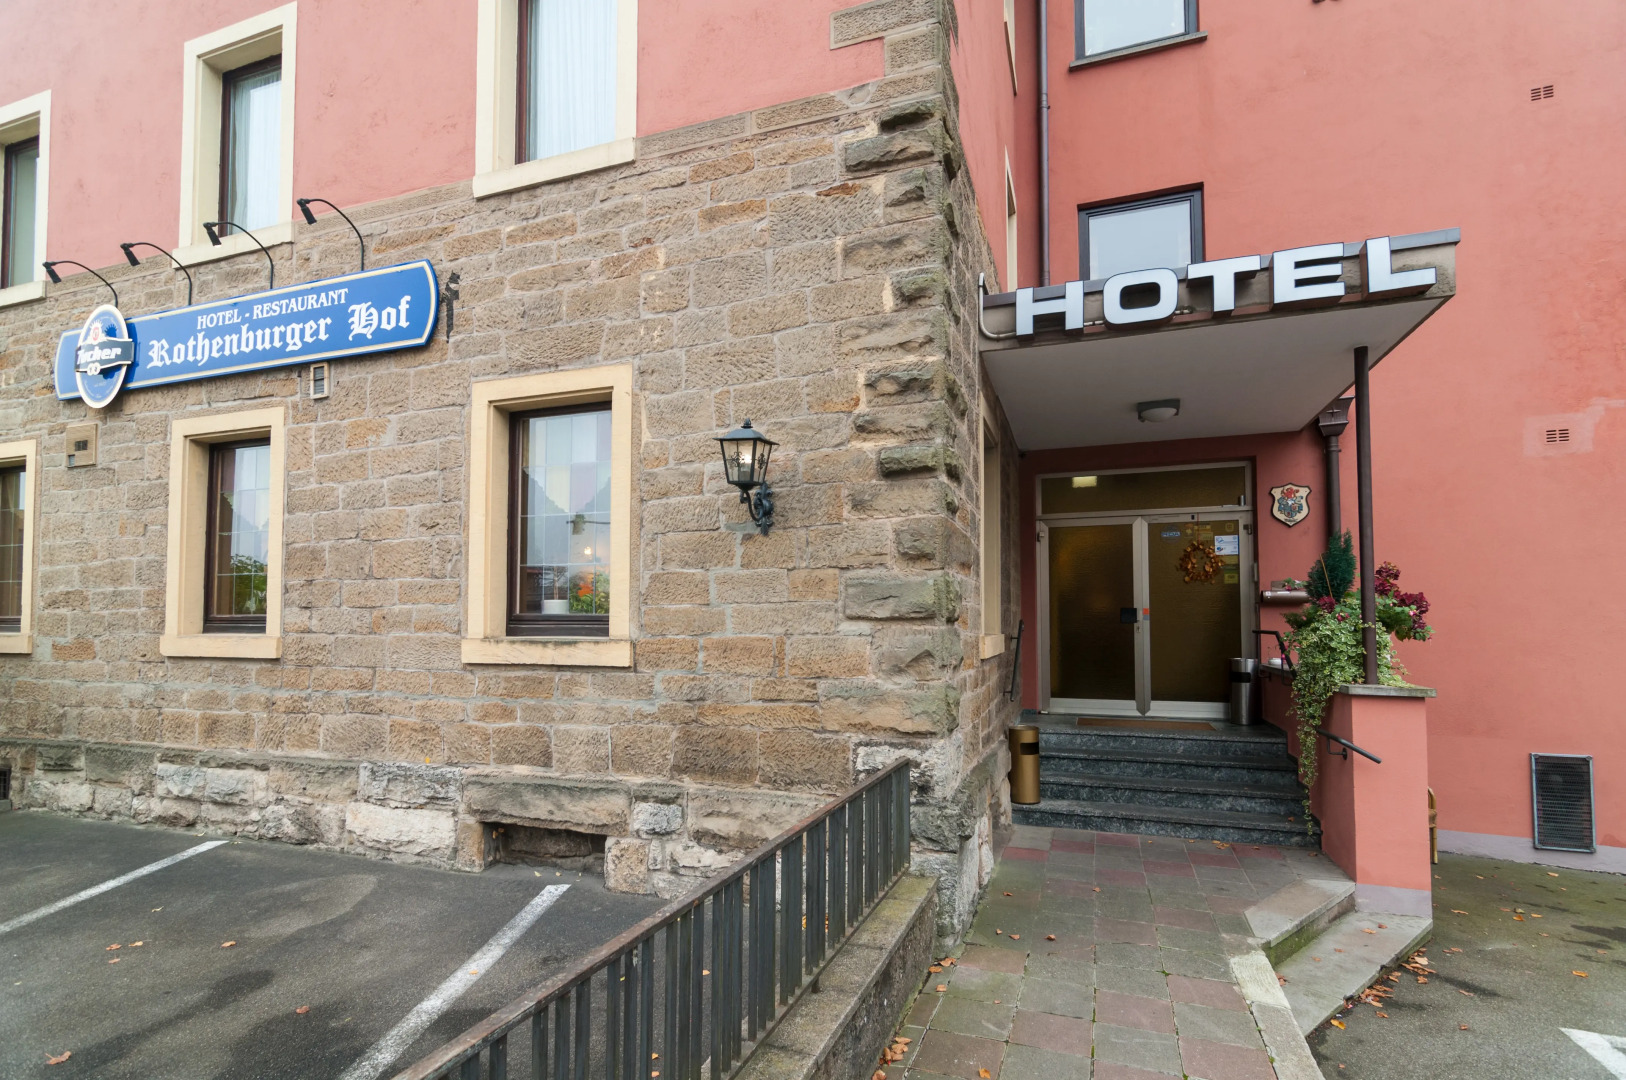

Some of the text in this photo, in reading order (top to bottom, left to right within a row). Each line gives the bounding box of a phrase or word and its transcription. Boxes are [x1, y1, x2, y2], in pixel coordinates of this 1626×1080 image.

[197, 309, 241, 329] HOTEL
[252, 288, 348, 319] RESTAURANT
[1015, 236, 1437, 336] HOTEL
[146, 295, 411, 368] Rothenburger Hof
